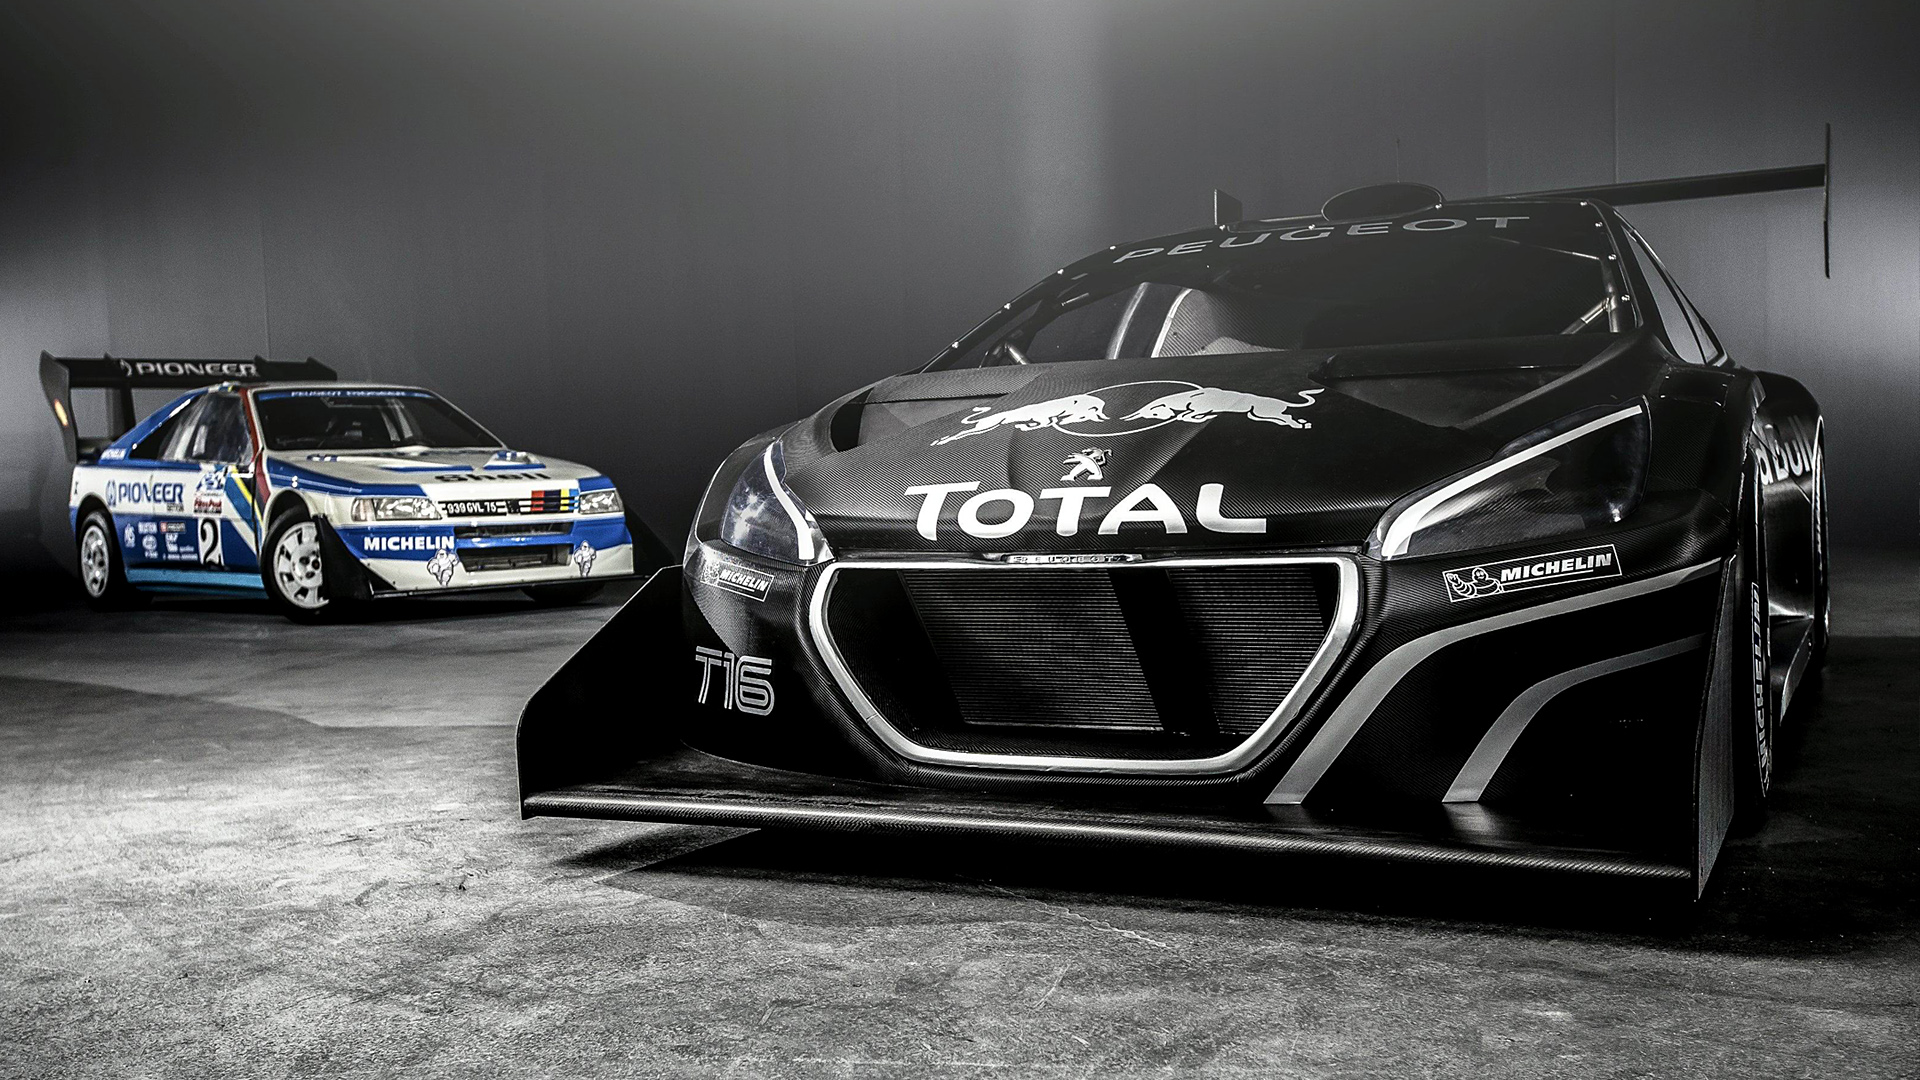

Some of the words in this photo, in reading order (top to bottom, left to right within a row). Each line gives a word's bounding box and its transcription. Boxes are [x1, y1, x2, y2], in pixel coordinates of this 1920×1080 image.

[1113, 216, 1530, 263] PEUGEOT
[136, 362, 260, 377] PIONEER
[435, 473, 551, 482] Shell
[119, 482, 184, 503] PIONEER
[447, 503, 466, 514] 939
[466, 502, 484, 513] GVL
[484, 501, 497, 512] 75
[200, 517, 224, 567] 2
[363, 536, 455, 551] MICHELIN
[1500, 553, 1612, 582] MICHELIN
[720, 569, 769, 592] MICHELIN
[695, 646, 775, 716] T16
